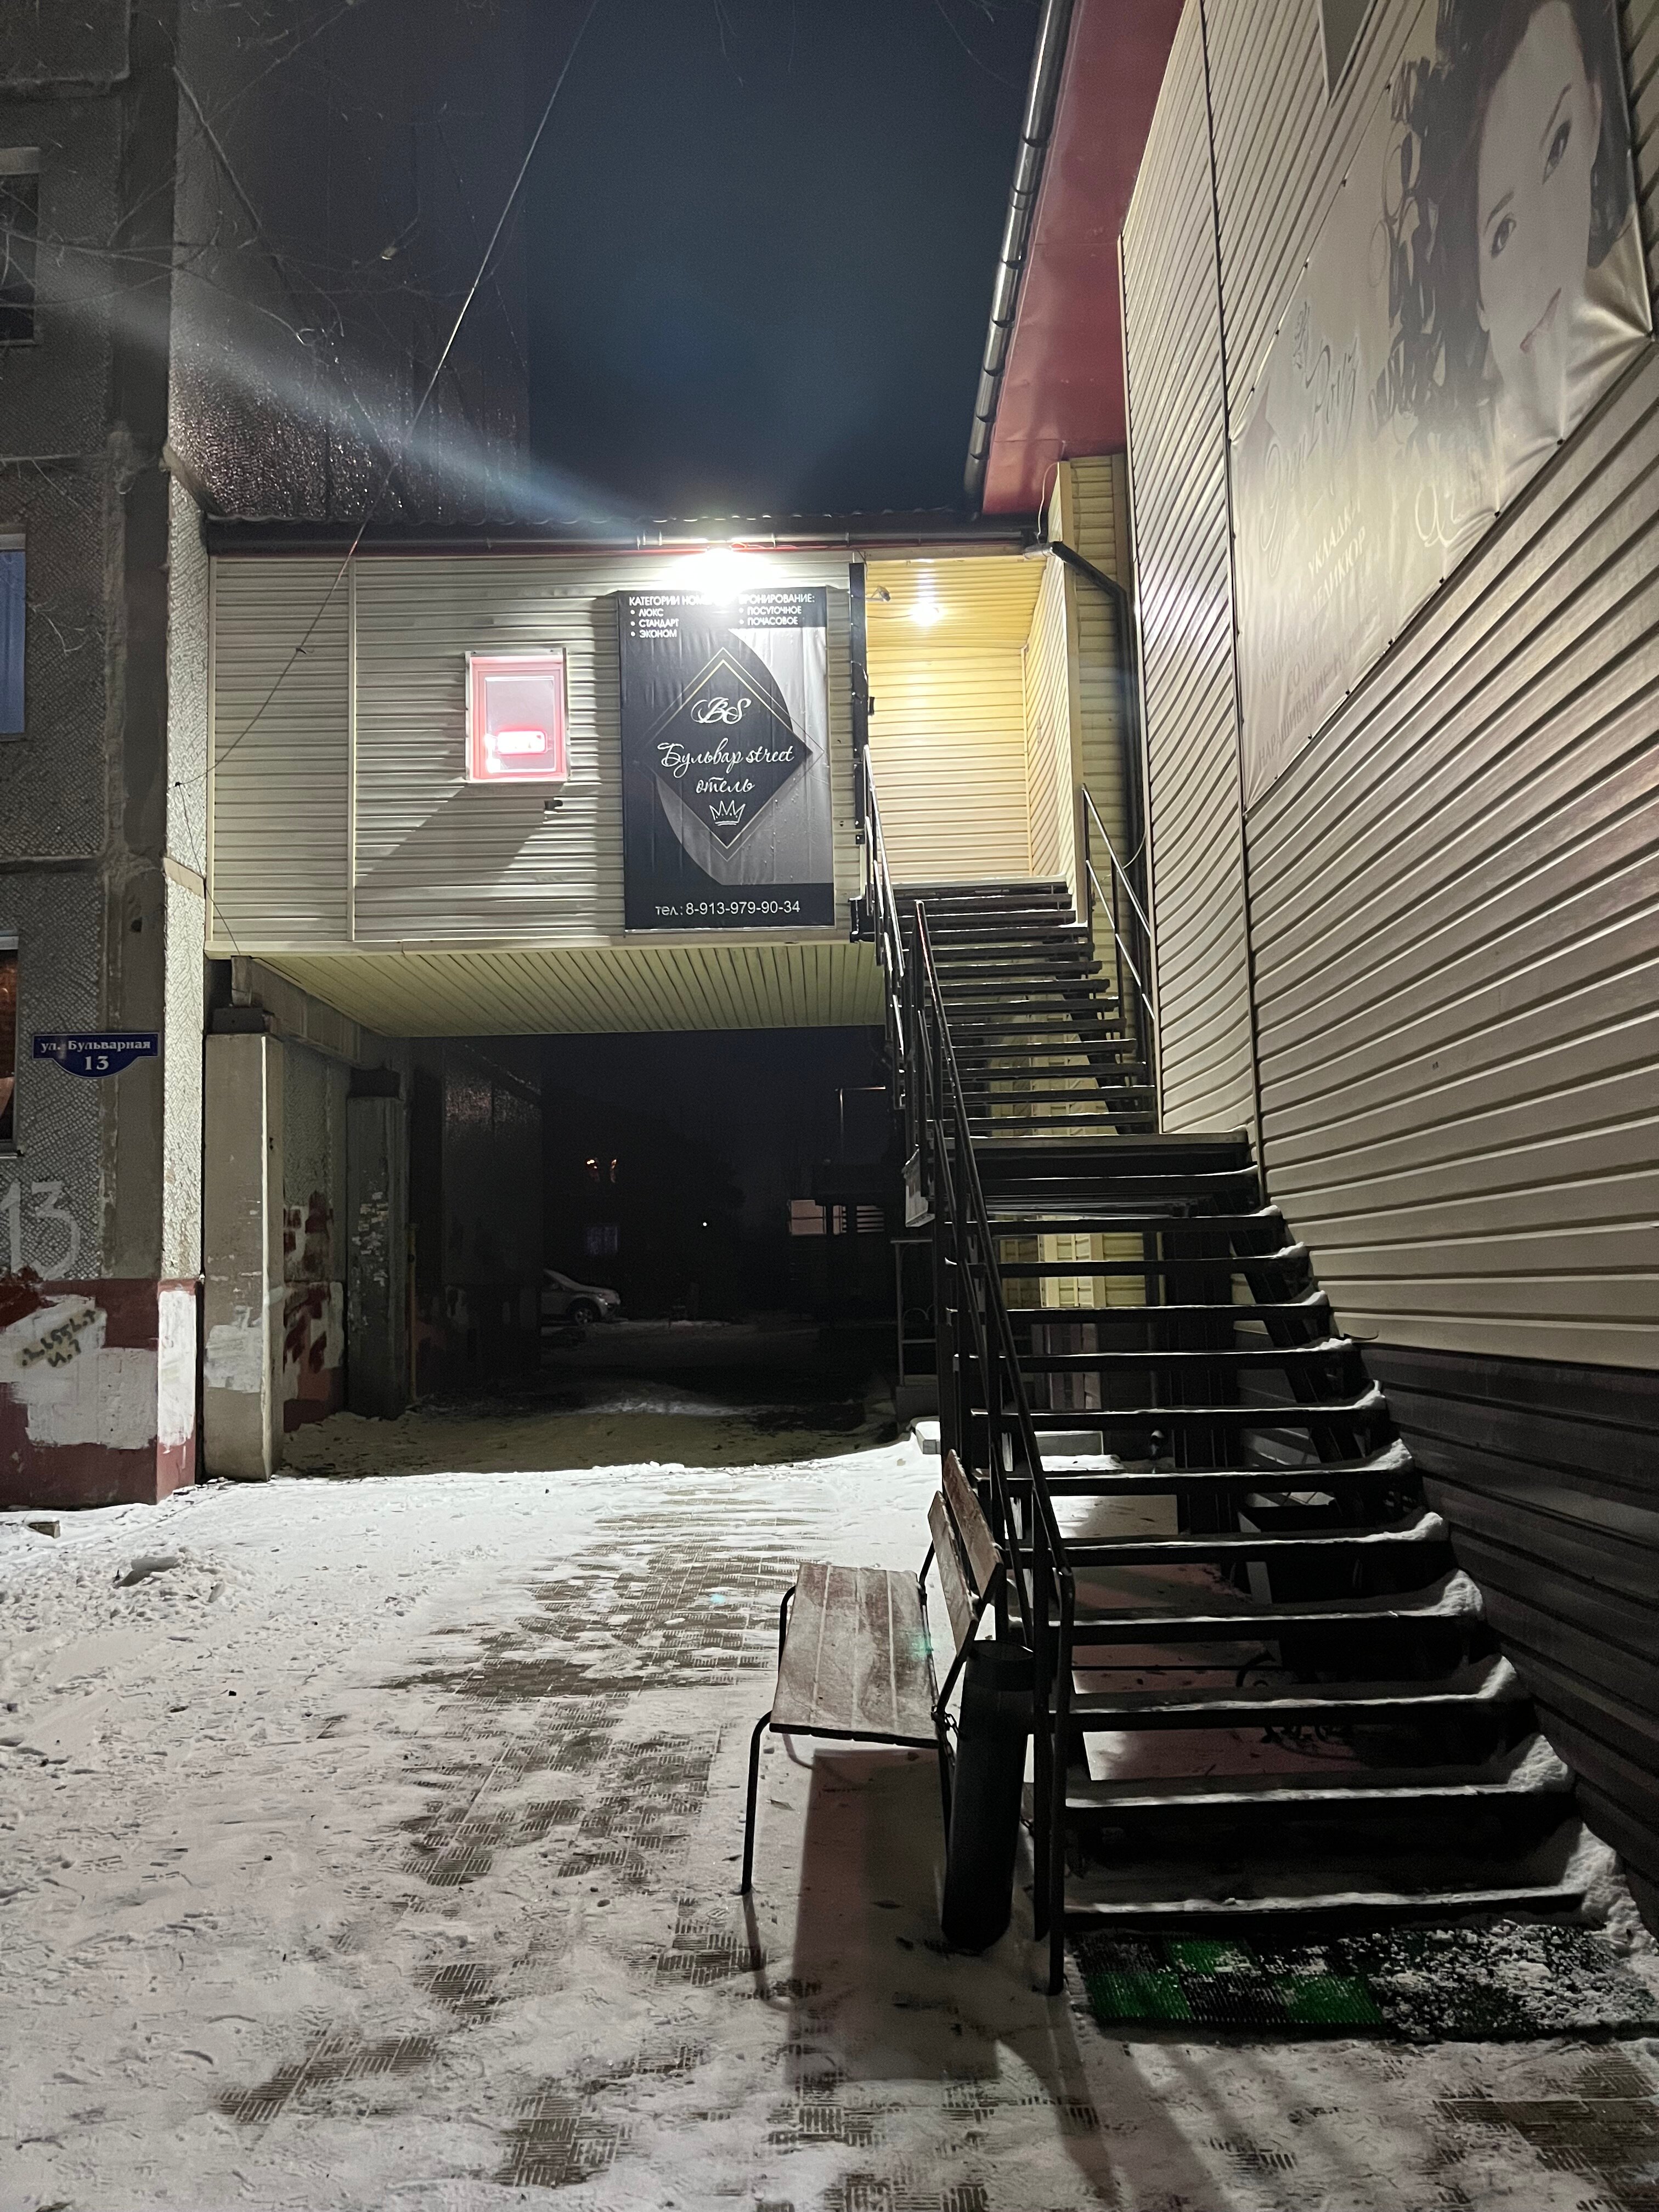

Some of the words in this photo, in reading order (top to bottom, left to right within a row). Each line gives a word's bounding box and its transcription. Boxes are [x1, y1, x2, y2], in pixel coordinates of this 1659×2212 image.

[629, 596, 680, 606] КАТЕГОРИИ
[638, 608, 664, 617] ЛЮКС
[747, 606, 802, 616] ПОСУТОЧНОЕ
[638, 618, 679, 628] СТАНДАРТ
[747, 616, 799, 626] ПОЧАСОВОЕ
[639, 629, 678, 638] ЭКОНОМ
[657, 737, 743, 778] Бульвар
[746, 746, 794, 763] street
[696, 776, 755, 794] отель
[685, 900, 800, 915] 8-913-979-90-34
[41, 1042, 61, 1053] ул.
[68, 1040, 151, 1052] Бульварная
[84, 1056, 109, 1070] 13
[0, 1180, 81, 1281] 13
